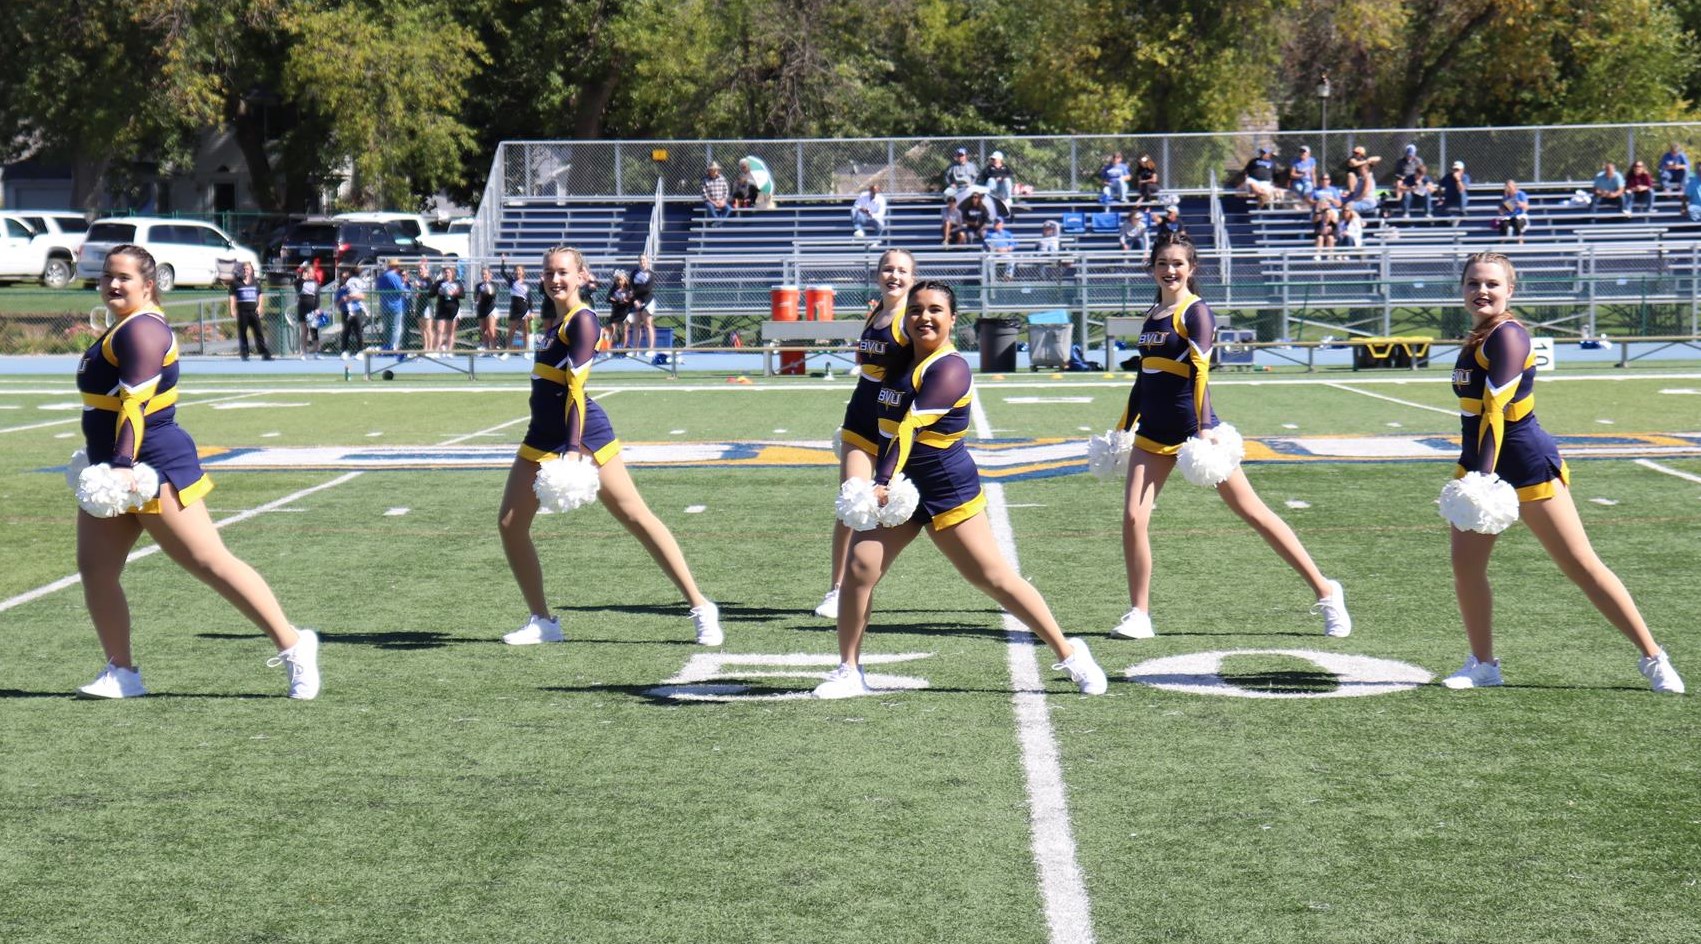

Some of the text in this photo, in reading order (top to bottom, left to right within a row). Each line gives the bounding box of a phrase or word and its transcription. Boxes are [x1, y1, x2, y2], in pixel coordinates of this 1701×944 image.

[859, 340, 888, 354] BVU
[1137, 331, 1169, 348] BVU
[1534, 343, 1549, 366] 10
[878, 388, 904, 408] BVU
